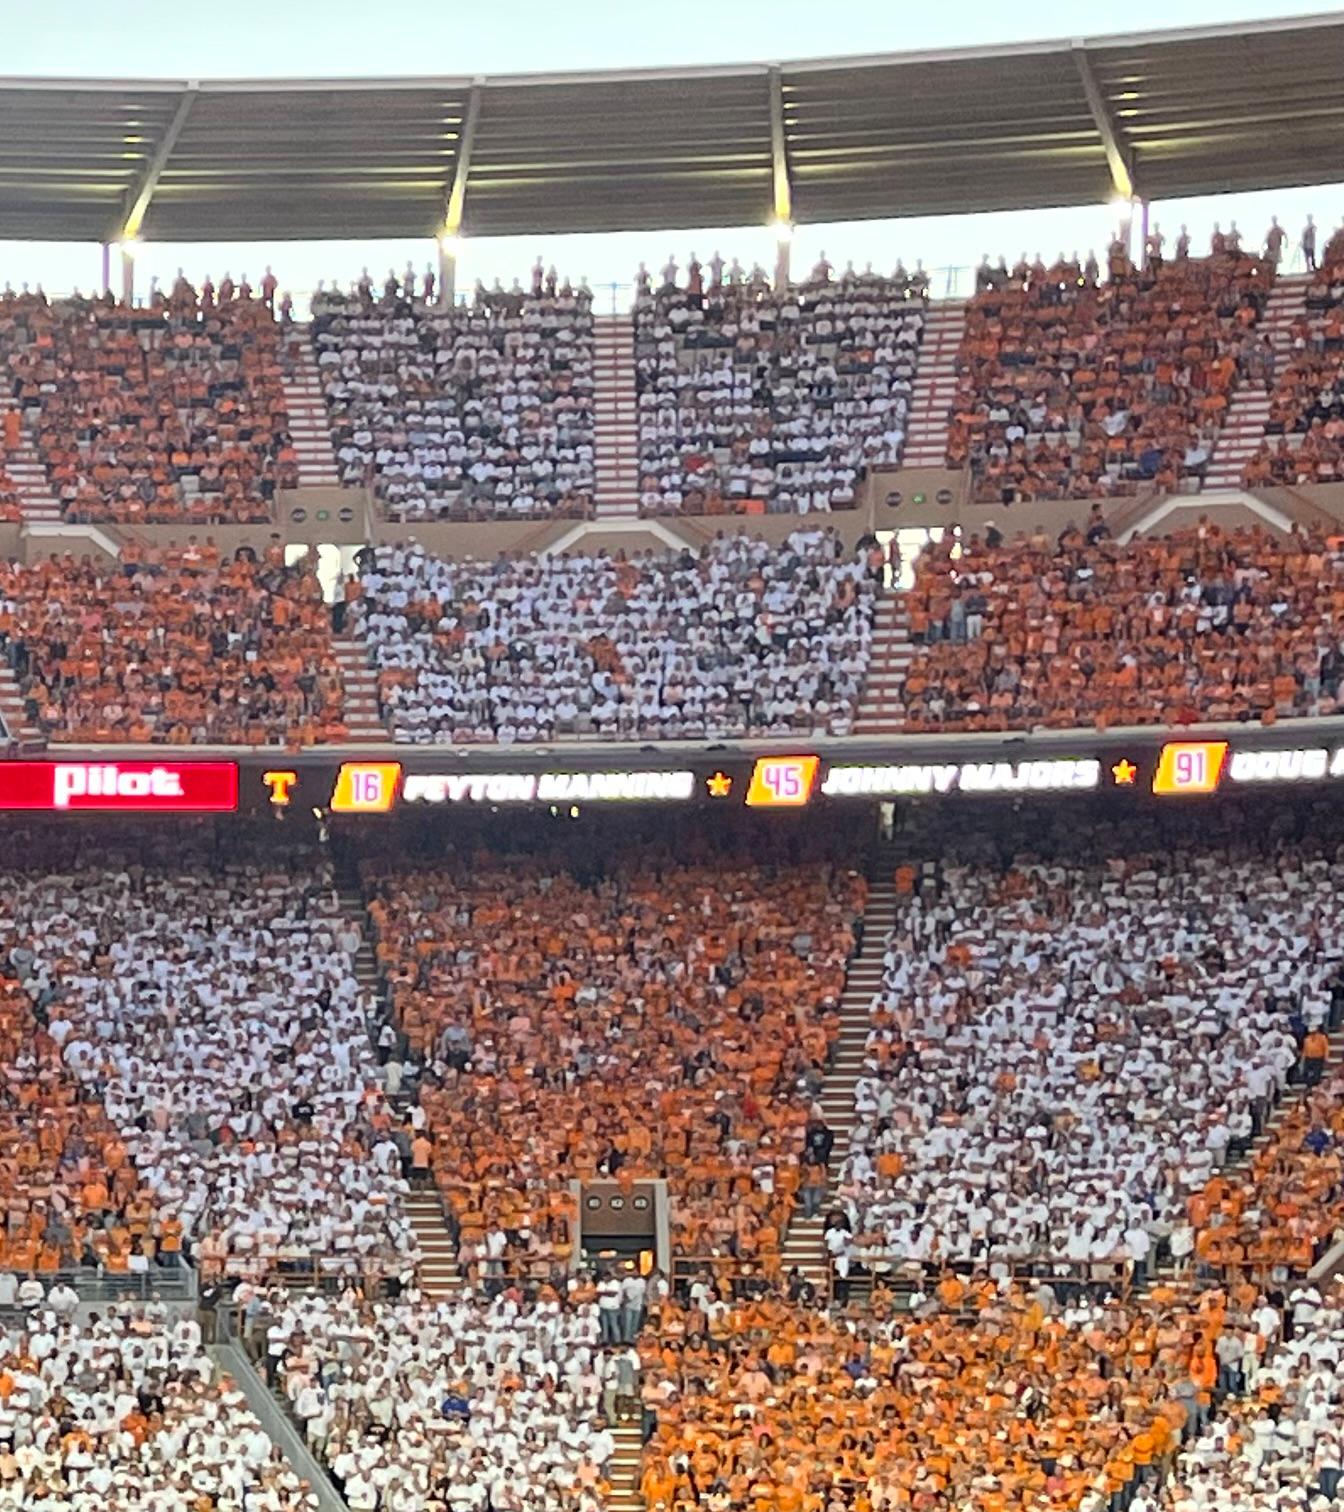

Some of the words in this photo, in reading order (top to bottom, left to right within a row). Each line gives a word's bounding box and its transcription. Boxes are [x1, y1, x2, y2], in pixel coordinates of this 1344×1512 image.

[761, 763, 800, 797] 45
[821, 764, 957, 794] JOHNNY
[959, 760, 1100, 790] MAJORS
[1176, 755, 1205, 785] 91
[263, 771, 298, 804] T
[352, 772, 379, 802] 16
[403, 774, 535, 800] PEYTON
